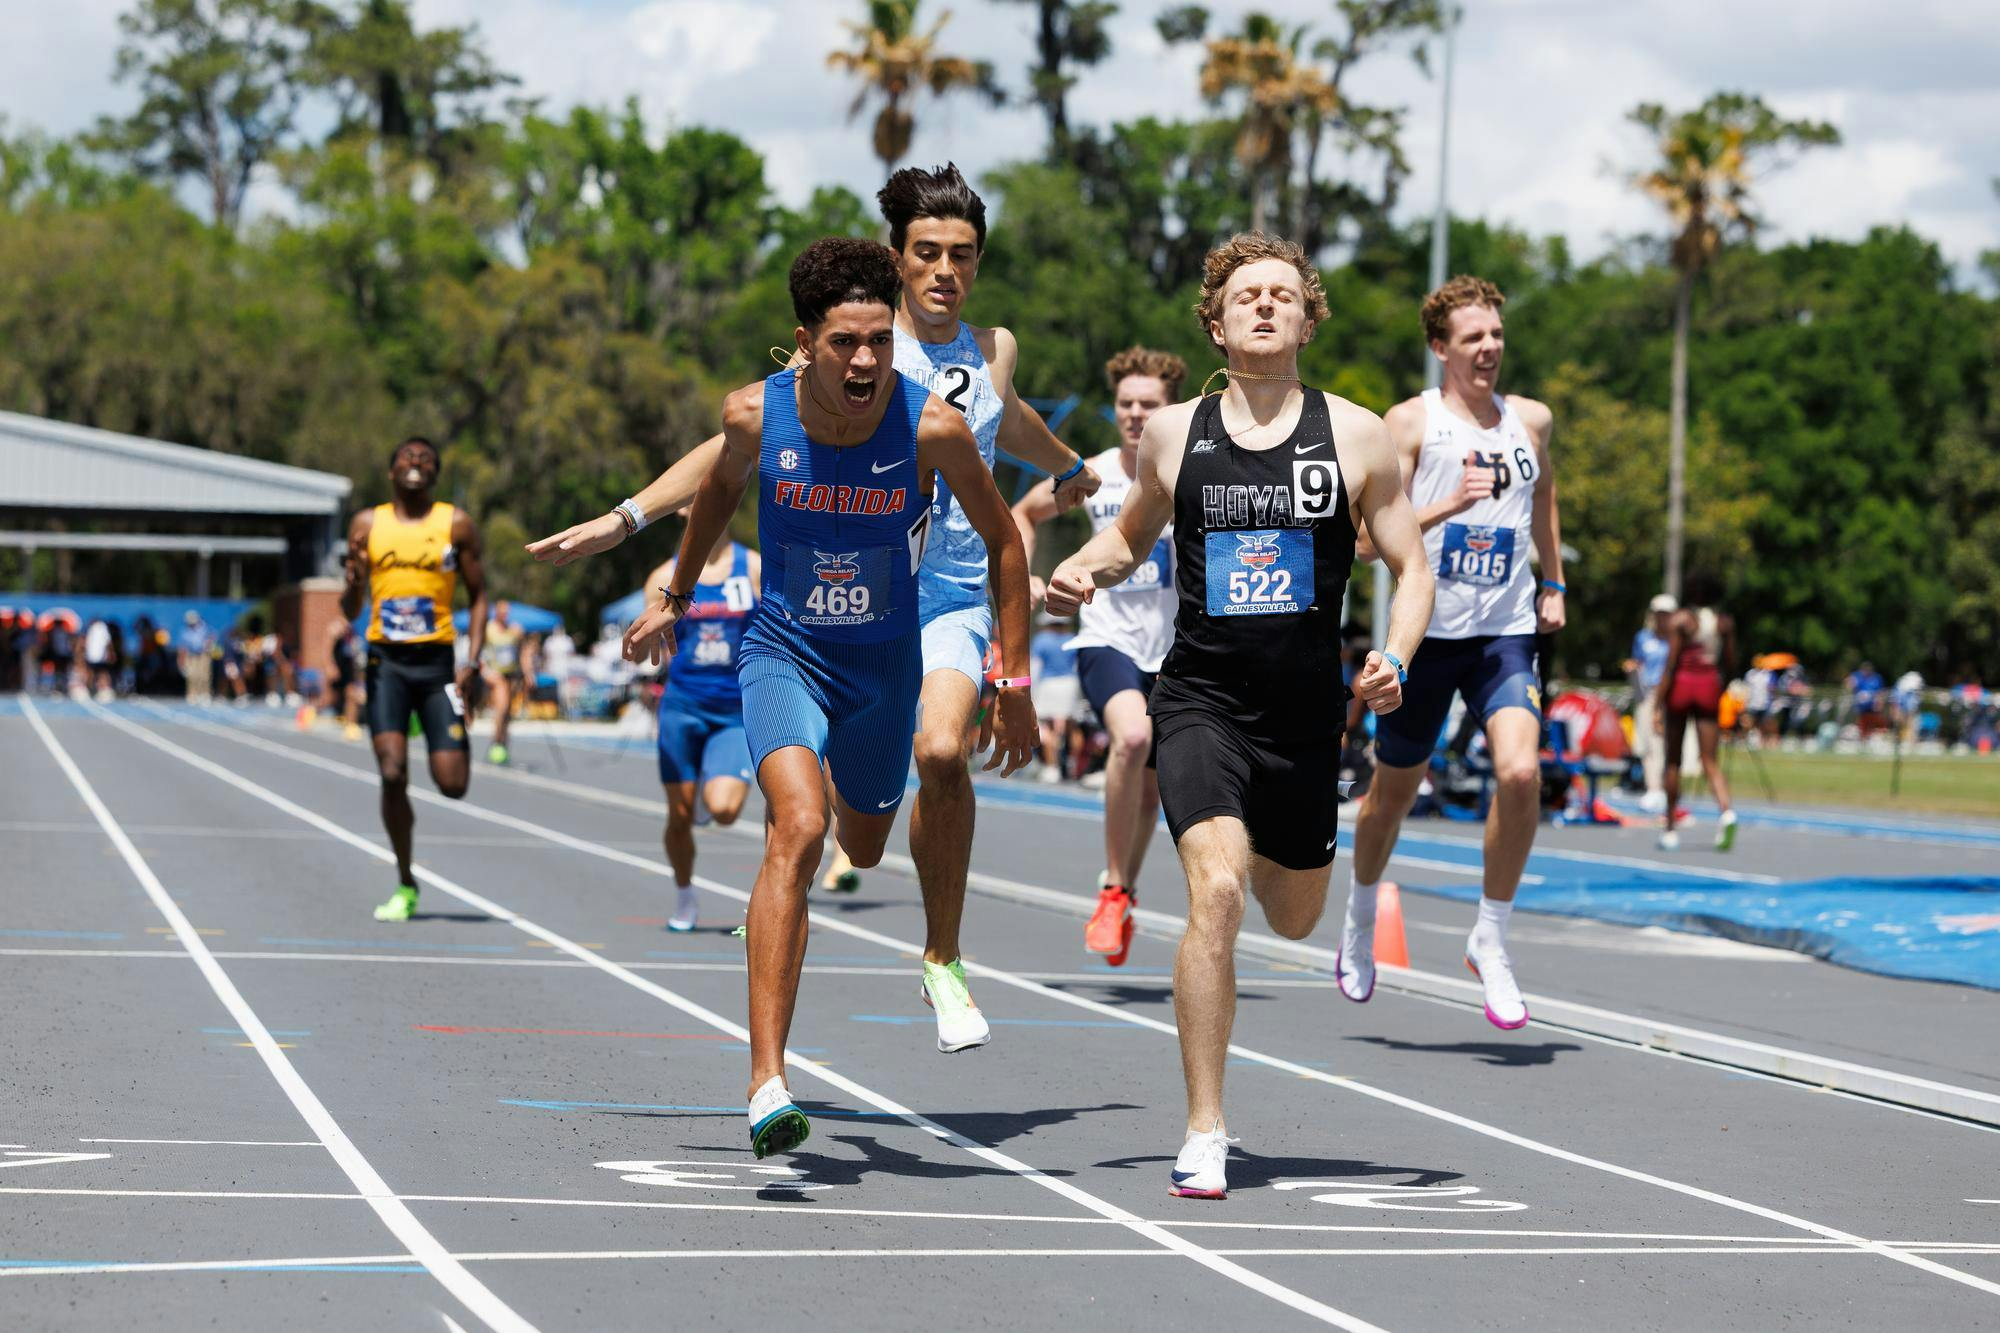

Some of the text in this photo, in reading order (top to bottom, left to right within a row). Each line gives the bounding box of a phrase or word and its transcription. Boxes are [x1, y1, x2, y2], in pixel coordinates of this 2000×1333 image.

[945, 367, 970, 413] 2
[1514, 447, 1533, 481] 6
[775, 480, 906, 515] FLORIDA
[1203, 485, 1314, 527] HOYA
[1300, 464, 1331, 514] 9
[1449, 549, 1506, 578] 1015
[806, 586, 869, 616] 469
[1229, 569, 1291, 603] 522
[799, 613, 874, 625] GAINESVILLE, FL
[1224, 602, 1299, 615] GAINESVILLE, FL
